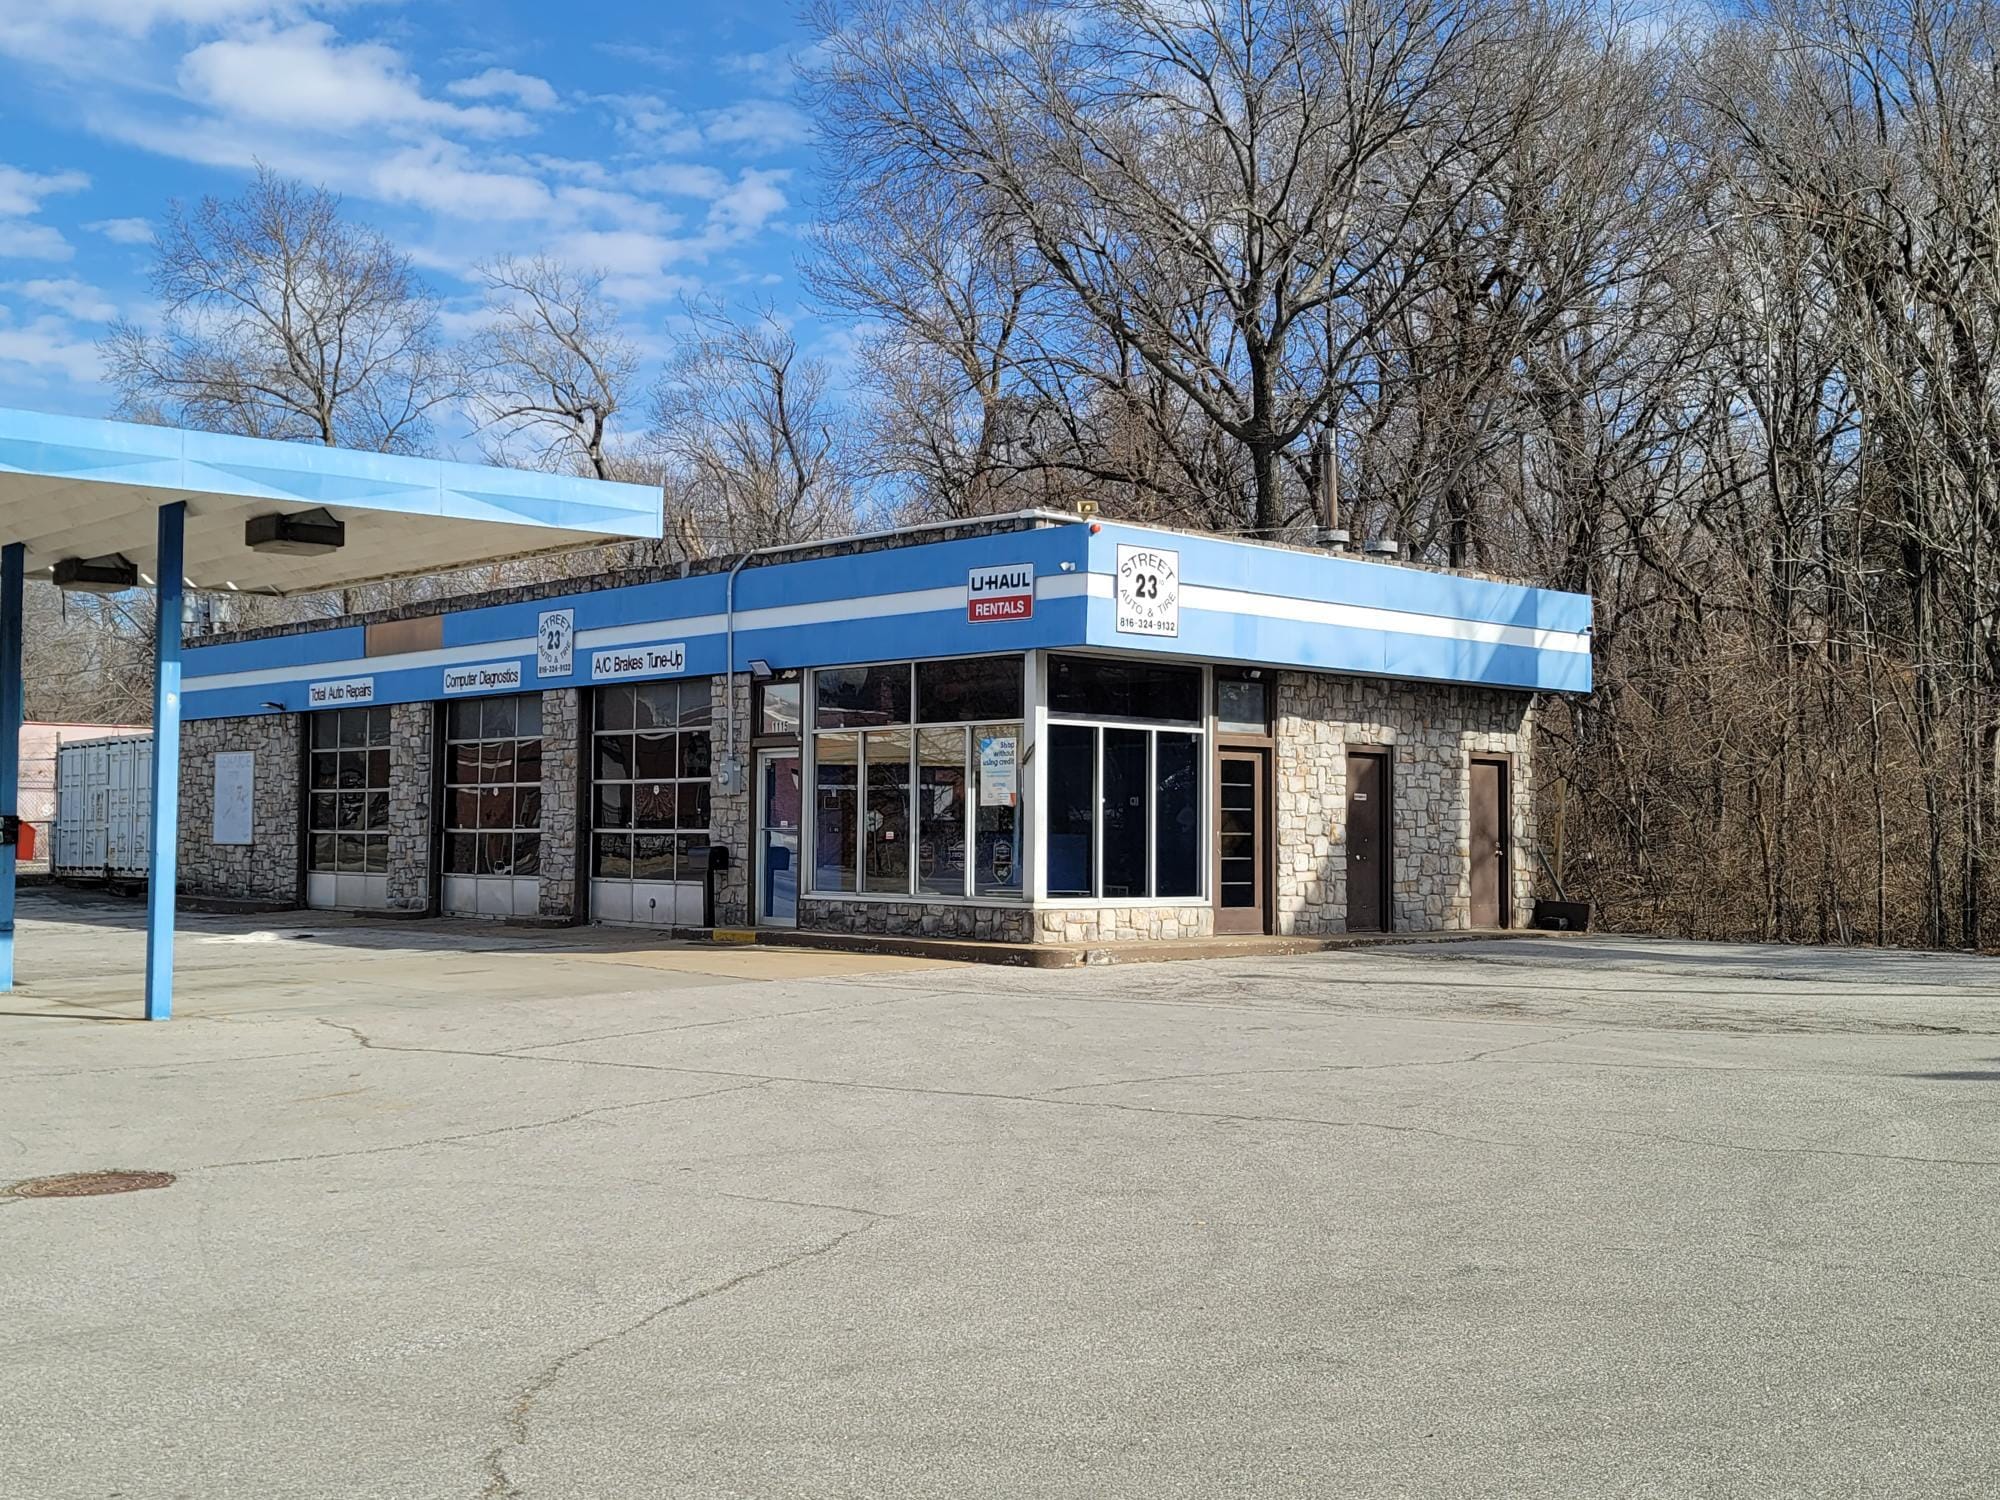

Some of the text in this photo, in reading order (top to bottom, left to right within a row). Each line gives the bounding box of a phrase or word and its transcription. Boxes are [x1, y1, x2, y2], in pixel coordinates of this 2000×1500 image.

[1121, 553, 1175, 577] STREET
[971, 572, 1030, 591] U-HAUL
[975, 600, 1024, 616] RENTALS
[1120, 589, 1176, 617] AUTO & TIRE
[540, 614, 571, 636] STREET
[1120, 617, 1175, 631] 816-324-9132
[539, 645, 552, 663] AUTO
[594, 650, 683, 673] A/C Brakes Tune-Up
[446, 667, 518, 690] Computer Diagnostics
[311, 683, 371, 701] Total Auto Repairs
[1000, 741, 1015, 749] Shop
[983, 759, 998, 767] using
